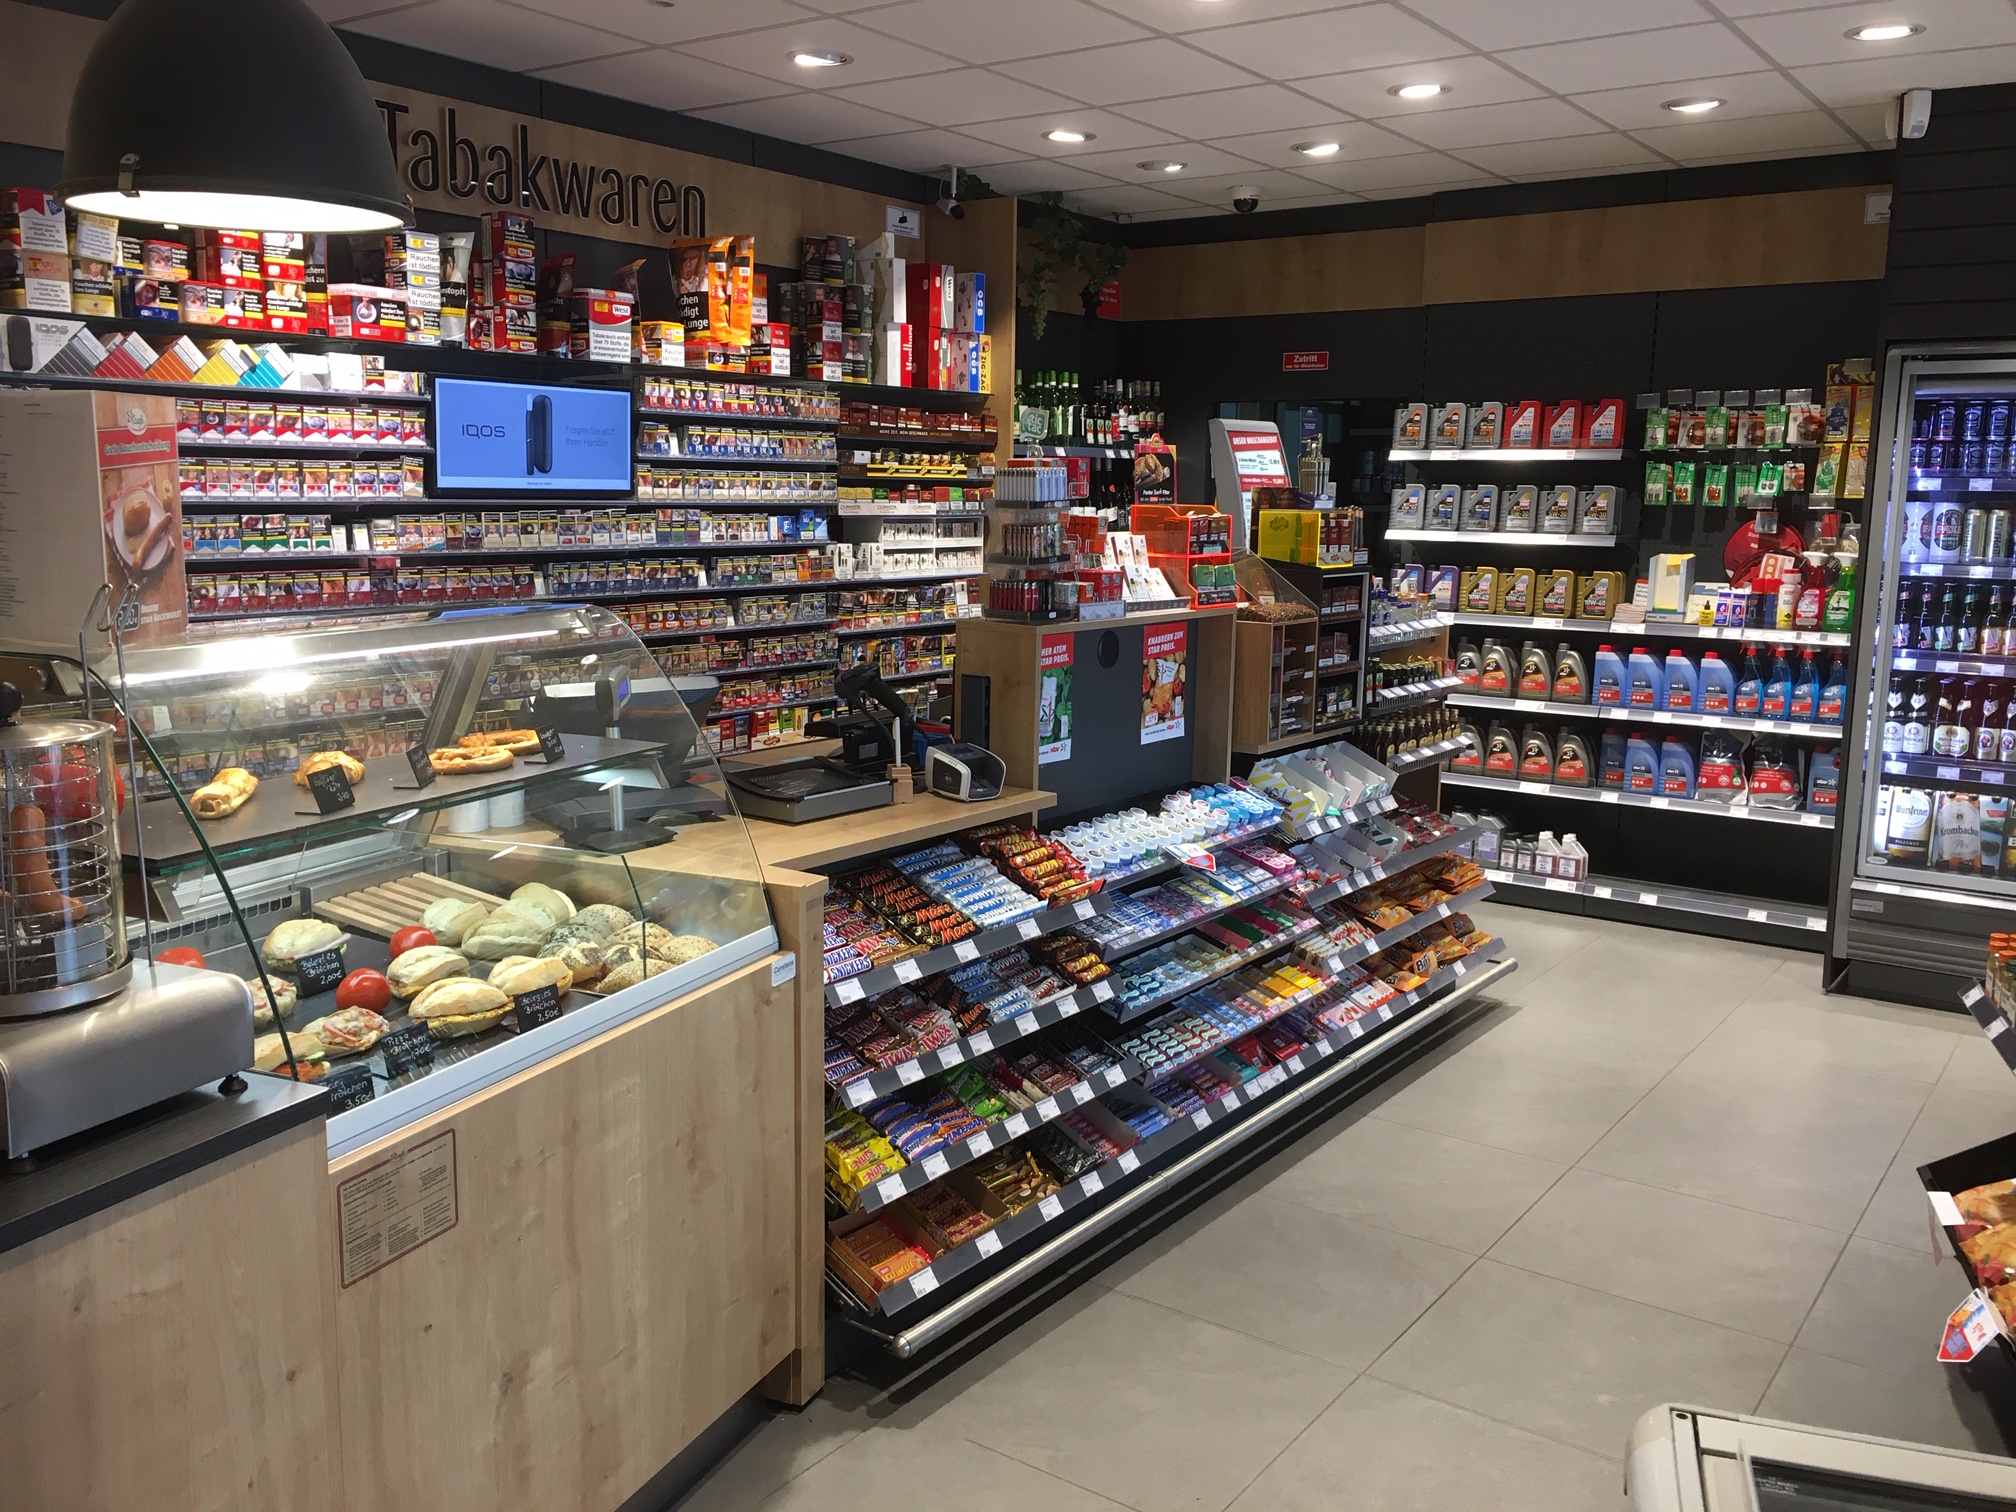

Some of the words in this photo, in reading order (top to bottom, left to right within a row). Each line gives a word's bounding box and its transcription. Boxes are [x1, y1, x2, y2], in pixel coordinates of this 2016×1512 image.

[375, 98, 706, 238] Tabakwaren
[613, 304, 630, 316] West
[976, 289, 984, 317] OCB
[35, 323, 70, 335] IQOS
[1293, 354, 1318, 363] Zutritt
[1030, 413, 1042, 425] tic
[461, 423, 506, 439] IQOS
[565, 424, 588, 436] Fragen
[589, 426, 601, 435] Sie
[1027, 423, 1042, 434] tac
[565, 437, 583, 446] Ihren
[584, 438, 609, 447] Händler
[1147, 633, 1174, 646] KNABBERN
[1174, 630, 1184, 640] ZUM
[1053, 644, 1067, 654] ATEM
[1147, 644, 1160, 655] STAR
[1160, 641, 1176, 652] PREIS.
[1053, 653, 1070, 664] PREIS.
[1895, 804, 1929, 818] Warsteiner
[1940, 825, 1980, 837] Krombacher
[1011, 839, 1036, 853] LION
[1025, 846, 1049, 862] LION
[898, 848, 933, 864] BOUNTY
[906, 858, 942, 872] BOUNTY
[929, 862, 964, 877] BOUNTY
[1036, 859, 1060, 875] LION
[860, 867, 895, 889] Mars
[939, 872, 975, 887] BOUNTY
[872, 876, 908, 897] Mars
[948, 881, 985, 896] BOUNTY
[885, 885, 919, 906] Mars
[960, 888, 995, 904] BOUNTY
[895, 894, 929, 914] Mars
[969, 896, 1005, 912] BOUNTY
[915, 902, 953, 925] Mars
[929, 911, 964, 935] Mars
[940, 920, 976, 945] Mars
[830, 957, 872, 981] SNICKERS
[1415, 952, 1430, 972] BiFi
[319, 969, 343, 985] 2,00€
[1088, 963, 1107, 979] LION
[1030, 978, 1054, 999] BOUNTY
[990, 988, 1021, 1007] BOUNTY
[537, 1007, 560, 1022] 2,50€
[960, 1002, 986, 1028] Mars
[1000, 1000, 1031, 1017] BOUNTY
[385, 1033, 409, 1046] Pizza
[918, 1024, 954, 1051] TWIX
[850, 1148, 875, 1169] Nuts
[863, 1160, 887, 1181] Nuts
